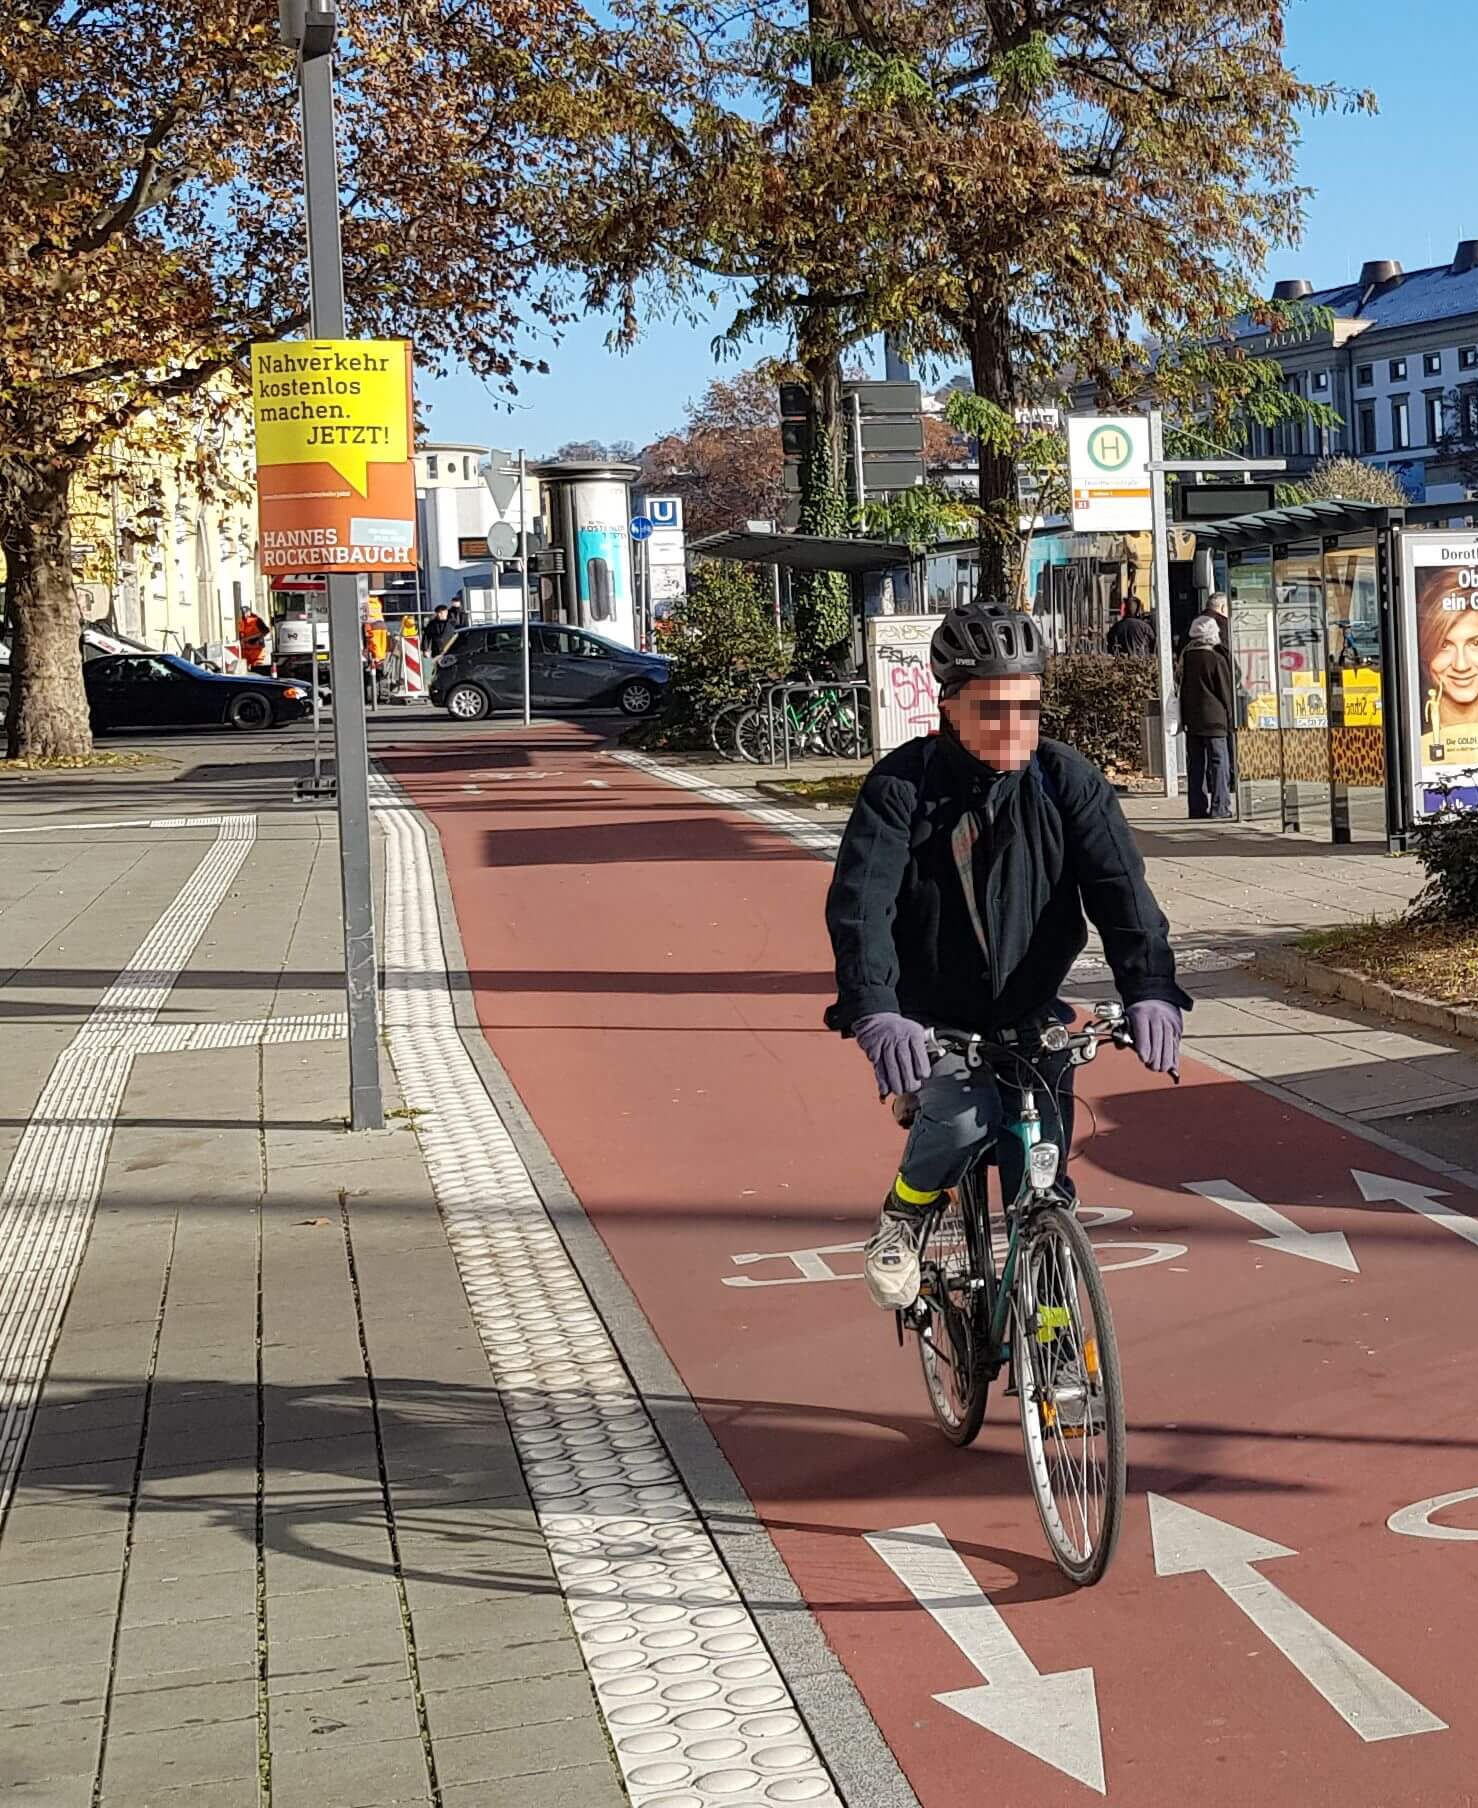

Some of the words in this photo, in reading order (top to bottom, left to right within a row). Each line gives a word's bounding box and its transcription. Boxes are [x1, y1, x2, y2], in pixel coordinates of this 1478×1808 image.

[257, 352, 389, 374] Nahverkehr
[259, 377, 361, 398] kostenlos
[260, 401, 351, 422] machen.
[307, 425, 389, 445] JETZT!
[1101, 435, 1121, 460] H
[653, 502, 673, 521] U
[263, 528, 338, 548] HANNES
[264, 546, 410, 567] ROCKENBAUCH
[1442, 593, 1466, 611] ein
